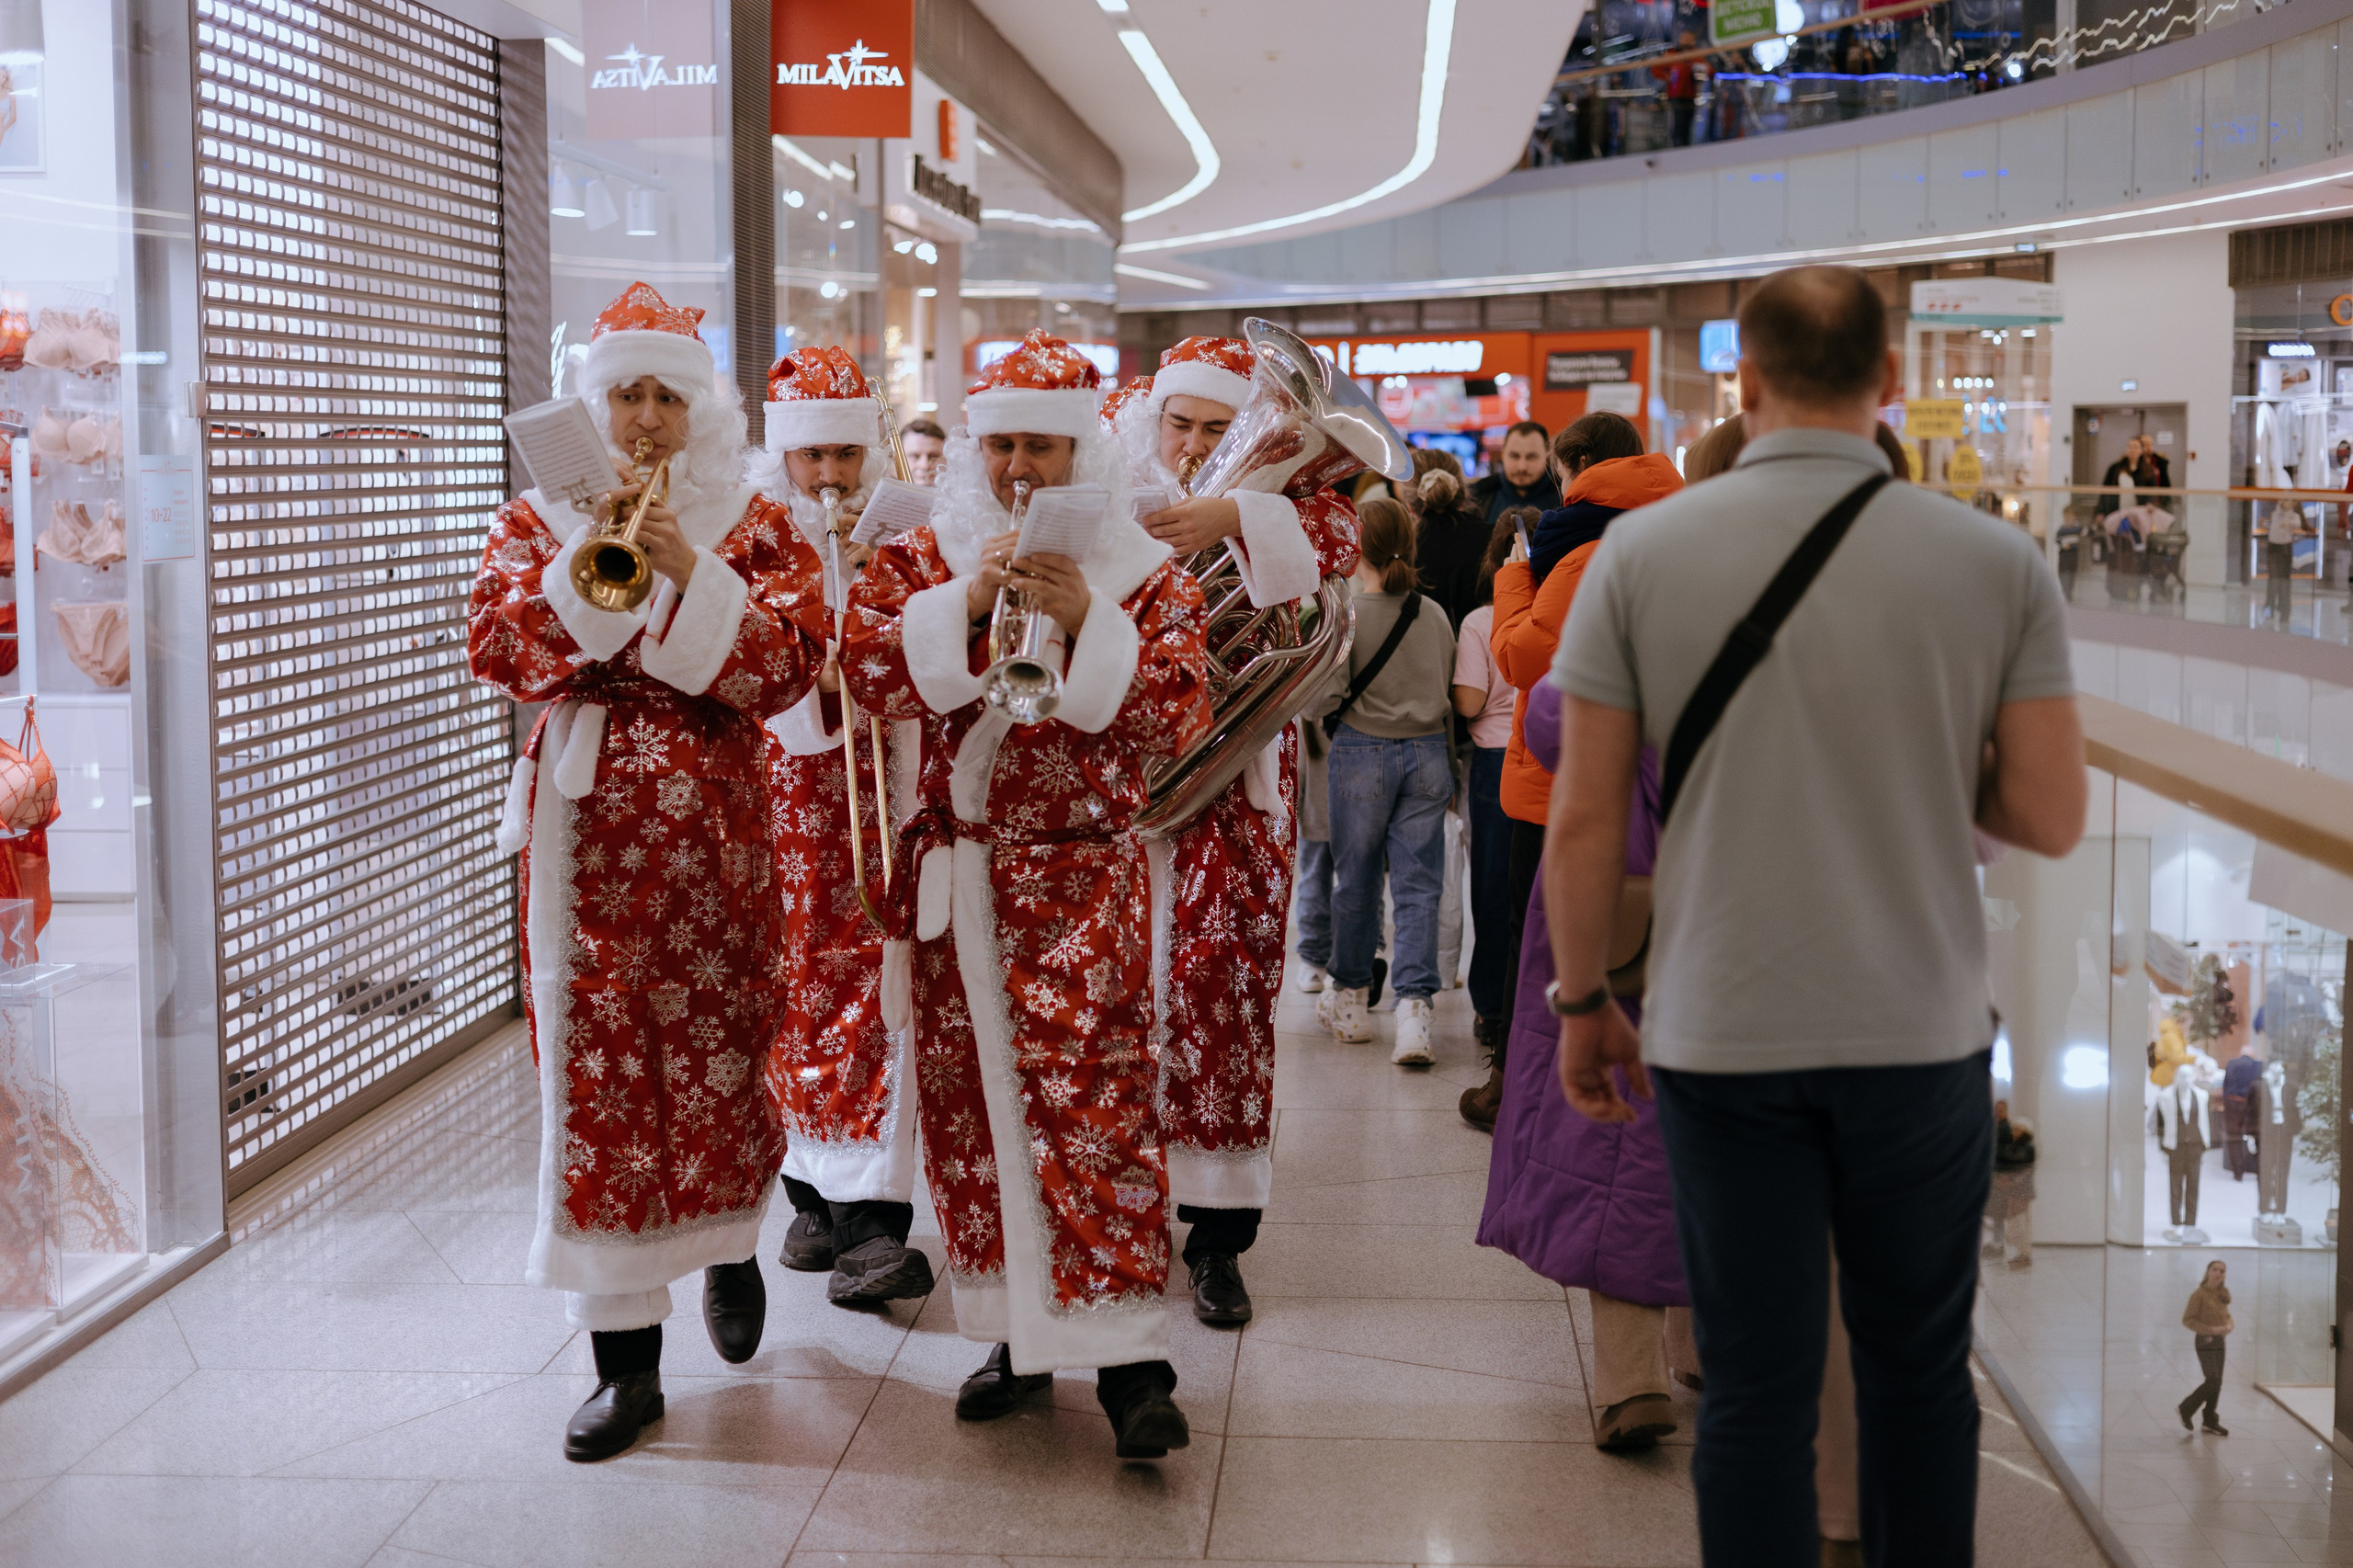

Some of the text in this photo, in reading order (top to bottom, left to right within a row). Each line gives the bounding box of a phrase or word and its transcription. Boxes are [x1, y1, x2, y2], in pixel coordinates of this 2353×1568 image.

[776, 53, 905, 90] MILAVITSA
[151, 506, 172, 523] 10-22
[5, 914, 32, 1196] MILVISA
